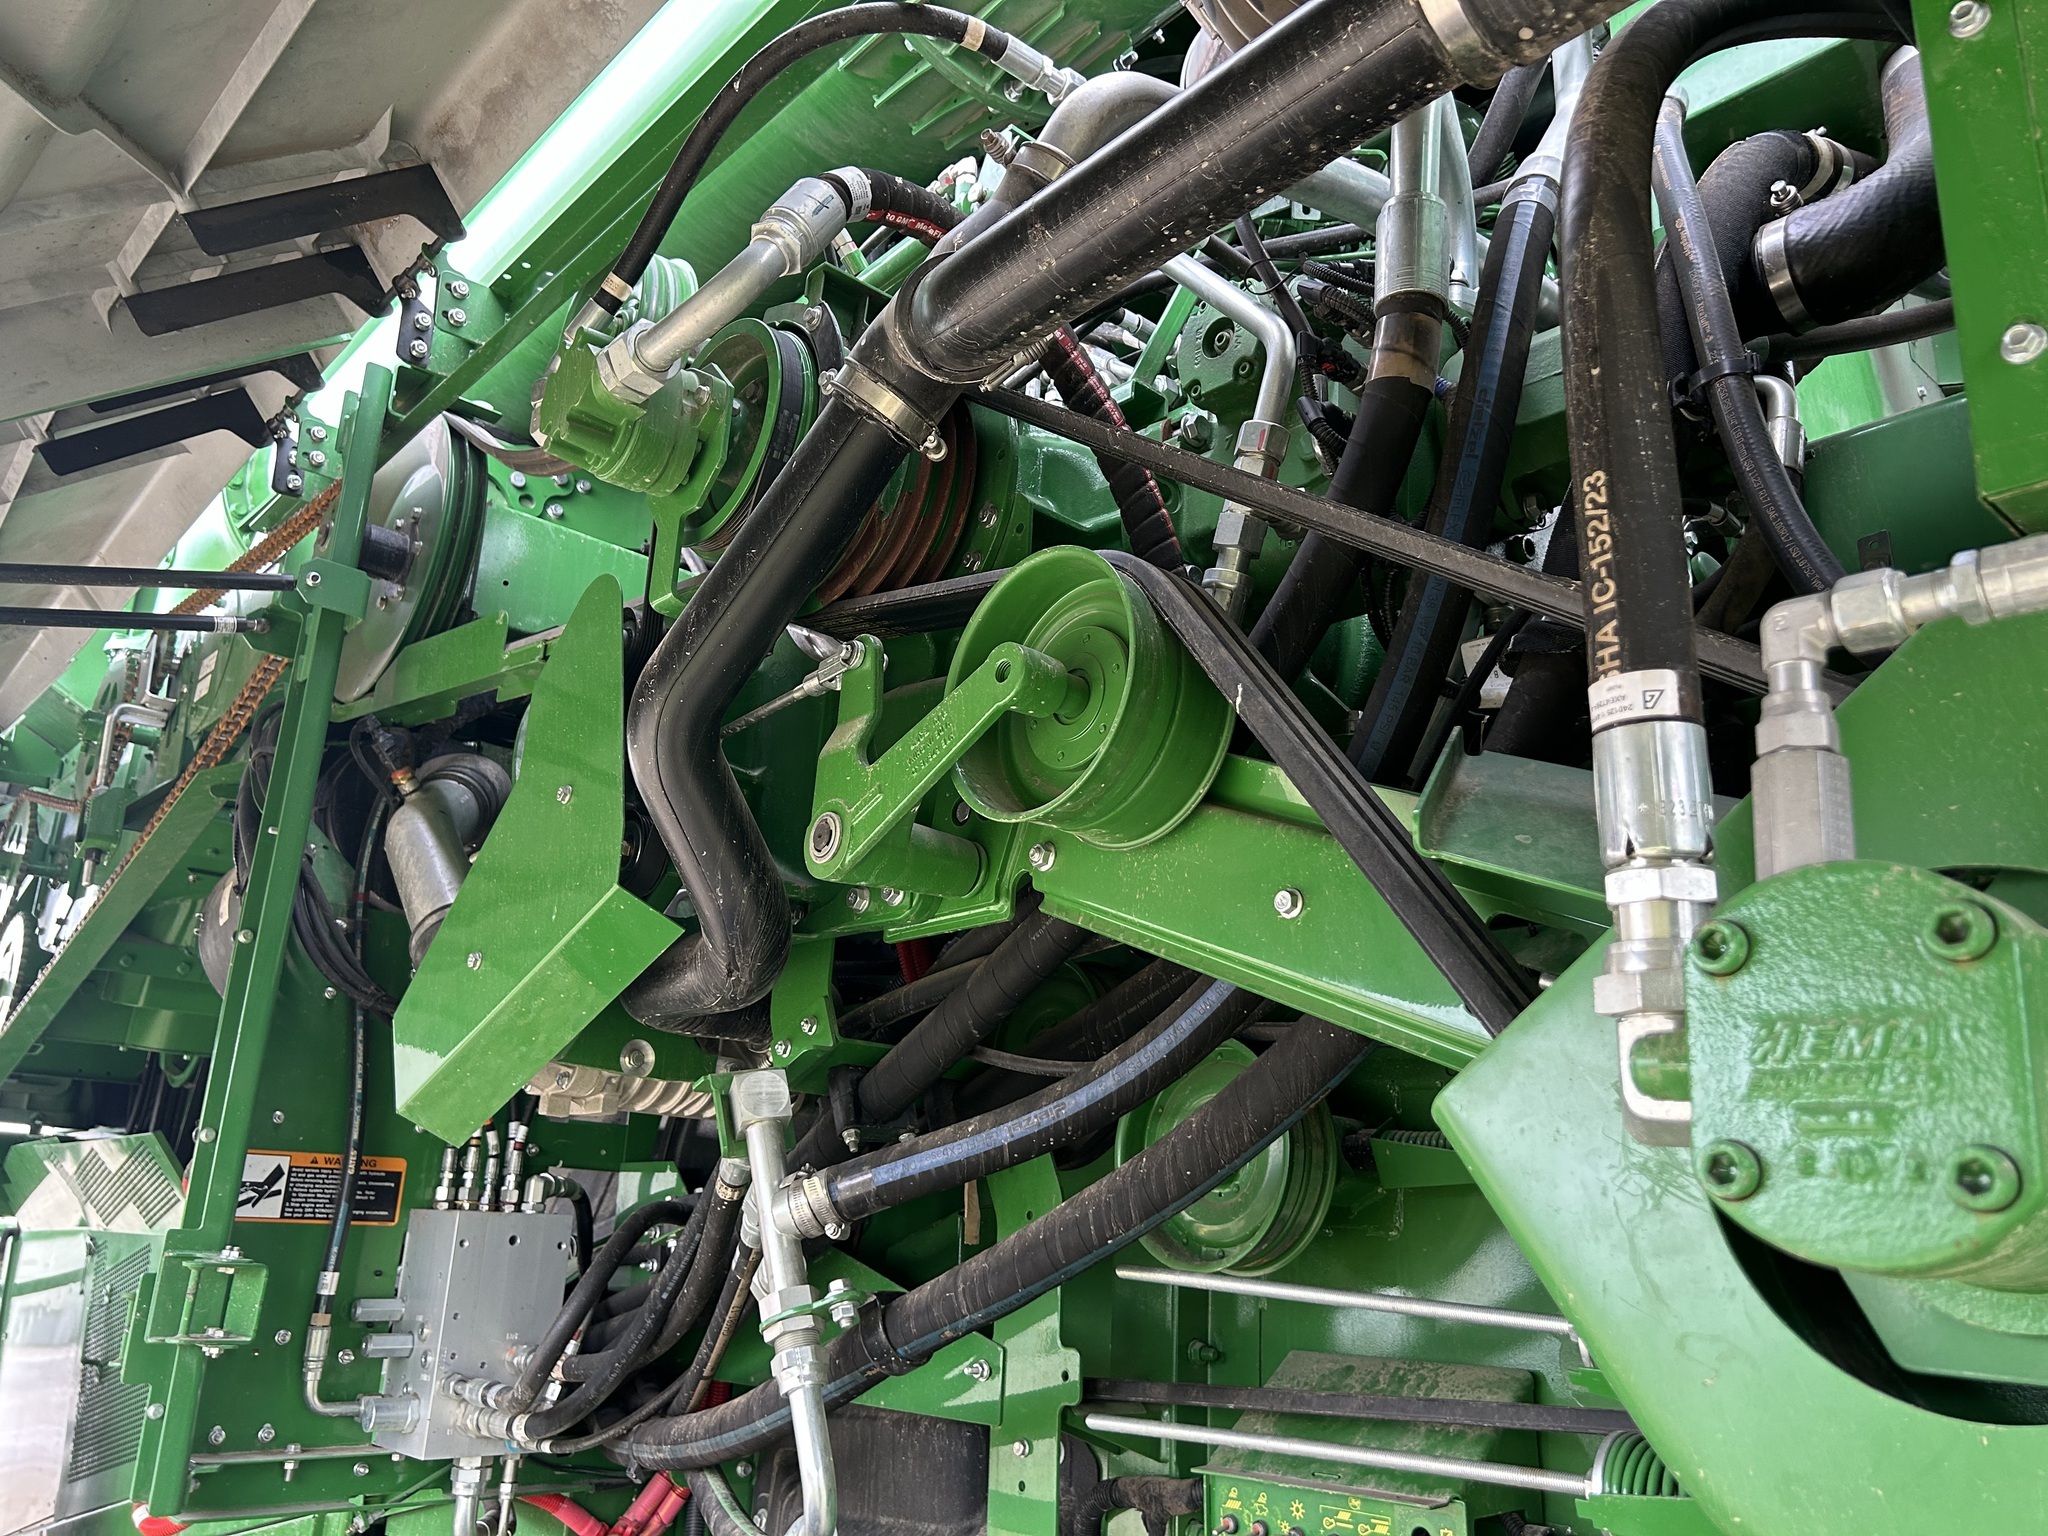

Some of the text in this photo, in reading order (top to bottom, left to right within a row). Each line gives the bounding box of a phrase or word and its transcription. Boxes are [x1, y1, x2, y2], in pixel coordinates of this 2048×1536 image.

[1714, 377, 1730, 398] (3250
[1729, 425, 1744, 445] (19.0
[1742, 457, 1755, 471] ISO
[1747, 468, 1763, 490] 11237
[1756, 488, 1770, 503] R17
[1764, 505, 1779, 522] SAE
[1771, 517, 1792, 544] 100R17
[1583, 470, 1617, 615] IC-152/23
[1787, 543, 1802, 558] ISO
[1793, 553, 1817, 578] 18752
[1808, 572, 1828, 592] Type
[1397, 655, 1416, 684] BAR
[1161, 1023, 1186, 1045] BAR
[1141, 1044, 1162, 1062] 145
[324, 1156, 377, 1168] WANG
